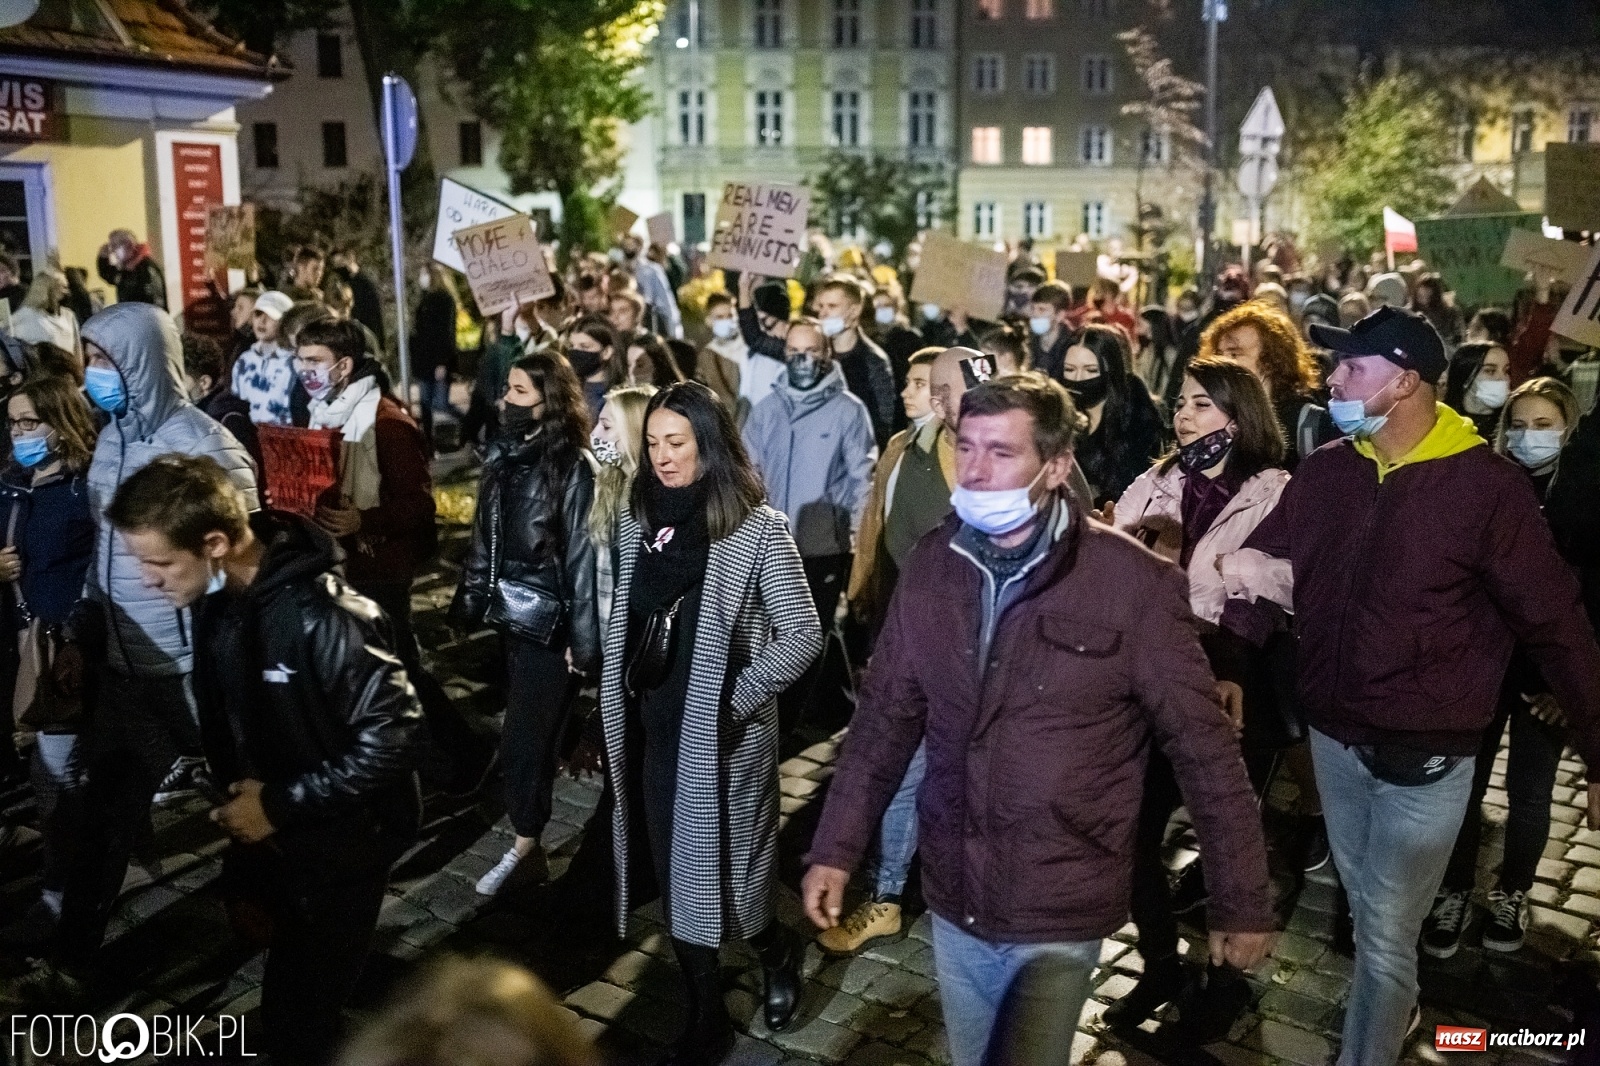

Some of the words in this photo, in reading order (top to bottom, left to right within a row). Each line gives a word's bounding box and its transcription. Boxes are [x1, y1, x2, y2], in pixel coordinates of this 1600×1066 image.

[723, 183, 763, 207] REAL
[766, 189, 801, 215] MEN
[732, 212, 773, 236] ARE
[711, 229, 799, 264] FEMINISTS
